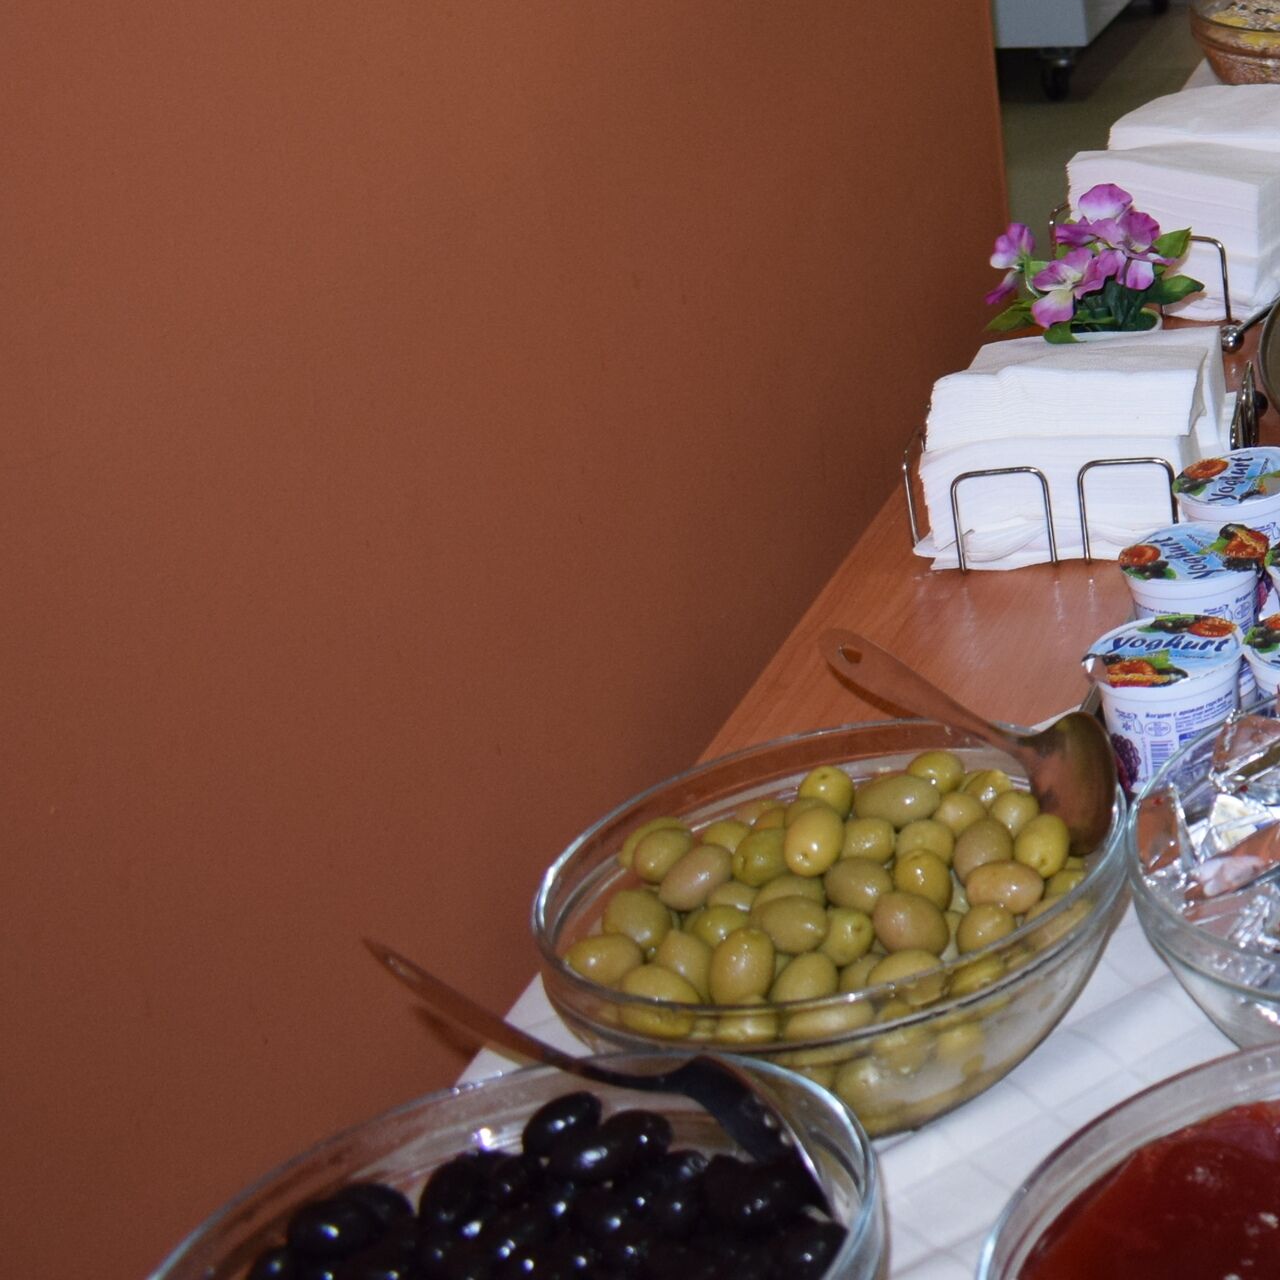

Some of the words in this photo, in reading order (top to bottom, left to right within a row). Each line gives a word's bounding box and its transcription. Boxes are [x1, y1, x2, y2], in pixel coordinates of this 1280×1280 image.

[1207, 455, 1254, 502] Yoghurt
[1147, 536, 1216, 580] Yoghurt
[1105, 634, 1231, 654] Yoghurt
